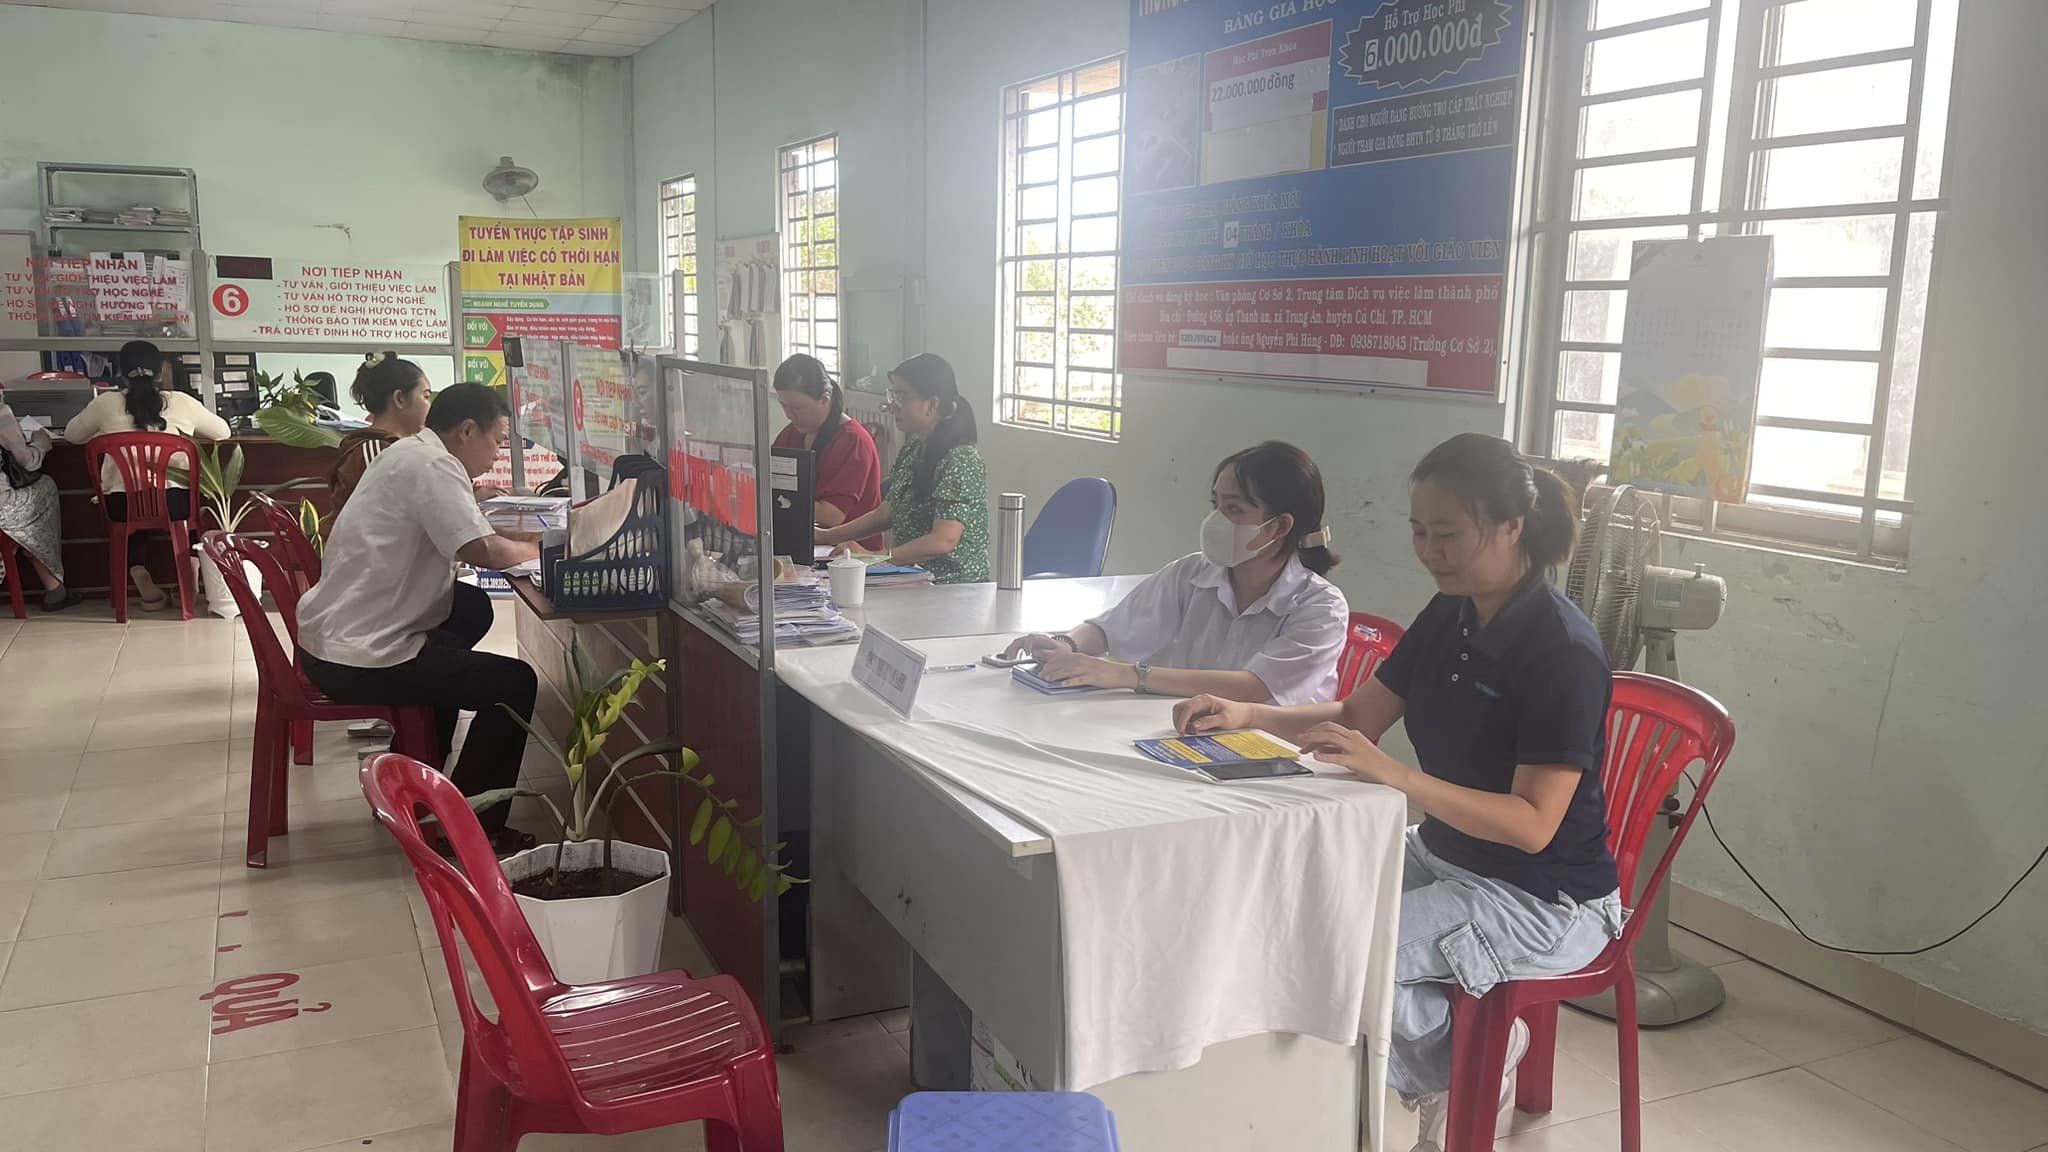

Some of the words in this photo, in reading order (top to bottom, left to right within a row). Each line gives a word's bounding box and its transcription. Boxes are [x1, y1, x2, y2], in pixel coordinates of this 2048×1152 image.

[1402, 9, 1421, 27] Trợ
[1423, 4, 1444, 23] Học
[469, 221, 511, 240] TUYỂN
[514, 225, 547, 244] THỰC
[551, 225, 575, 244] TẬP
[578, 227, 608, 241] SINH
[96, 258, 138, 272] NHẬN
[462, 250, 475, 263] ĐI
[479, 247, 504, 263] LÀM
[508, 248, 536, 267] VIỆC
[540, 247, 557, 264] CÓ
[561, 248, 589, 264] THỜI
[594, 250, 620, 268] HẠN
[302, 265, 327, 278] NƠI
[364, 267, 402, 282] NHẬN
[498, 272, 519, 290] TẠI
[522, 270, 557, 290] NHẬT
[560, 269, 585, 287] BẢN
[104, 287, 129, 298] HỌC
[222, 286, 241, 314] 6
[371, 295, 393, 306] HỌC
[1296, 287, 1323, 305] Trung
[1326, 287, 1344, 301] tâm
[1347, 286, 1369, 302] Dịch
[1373, 289, 1385, 302] vụ
[1388, 286, 1410, 302] việc
[1414, 285, 1434, 301] làm
[1438, 285, 1473, 301] thành
[151, 301, 178, 311] TCTN
[411, 307, 437, 317] TCTN
[1409, 309, 1433, 326] HCM
[395, 329, 417, 341] HỌC
